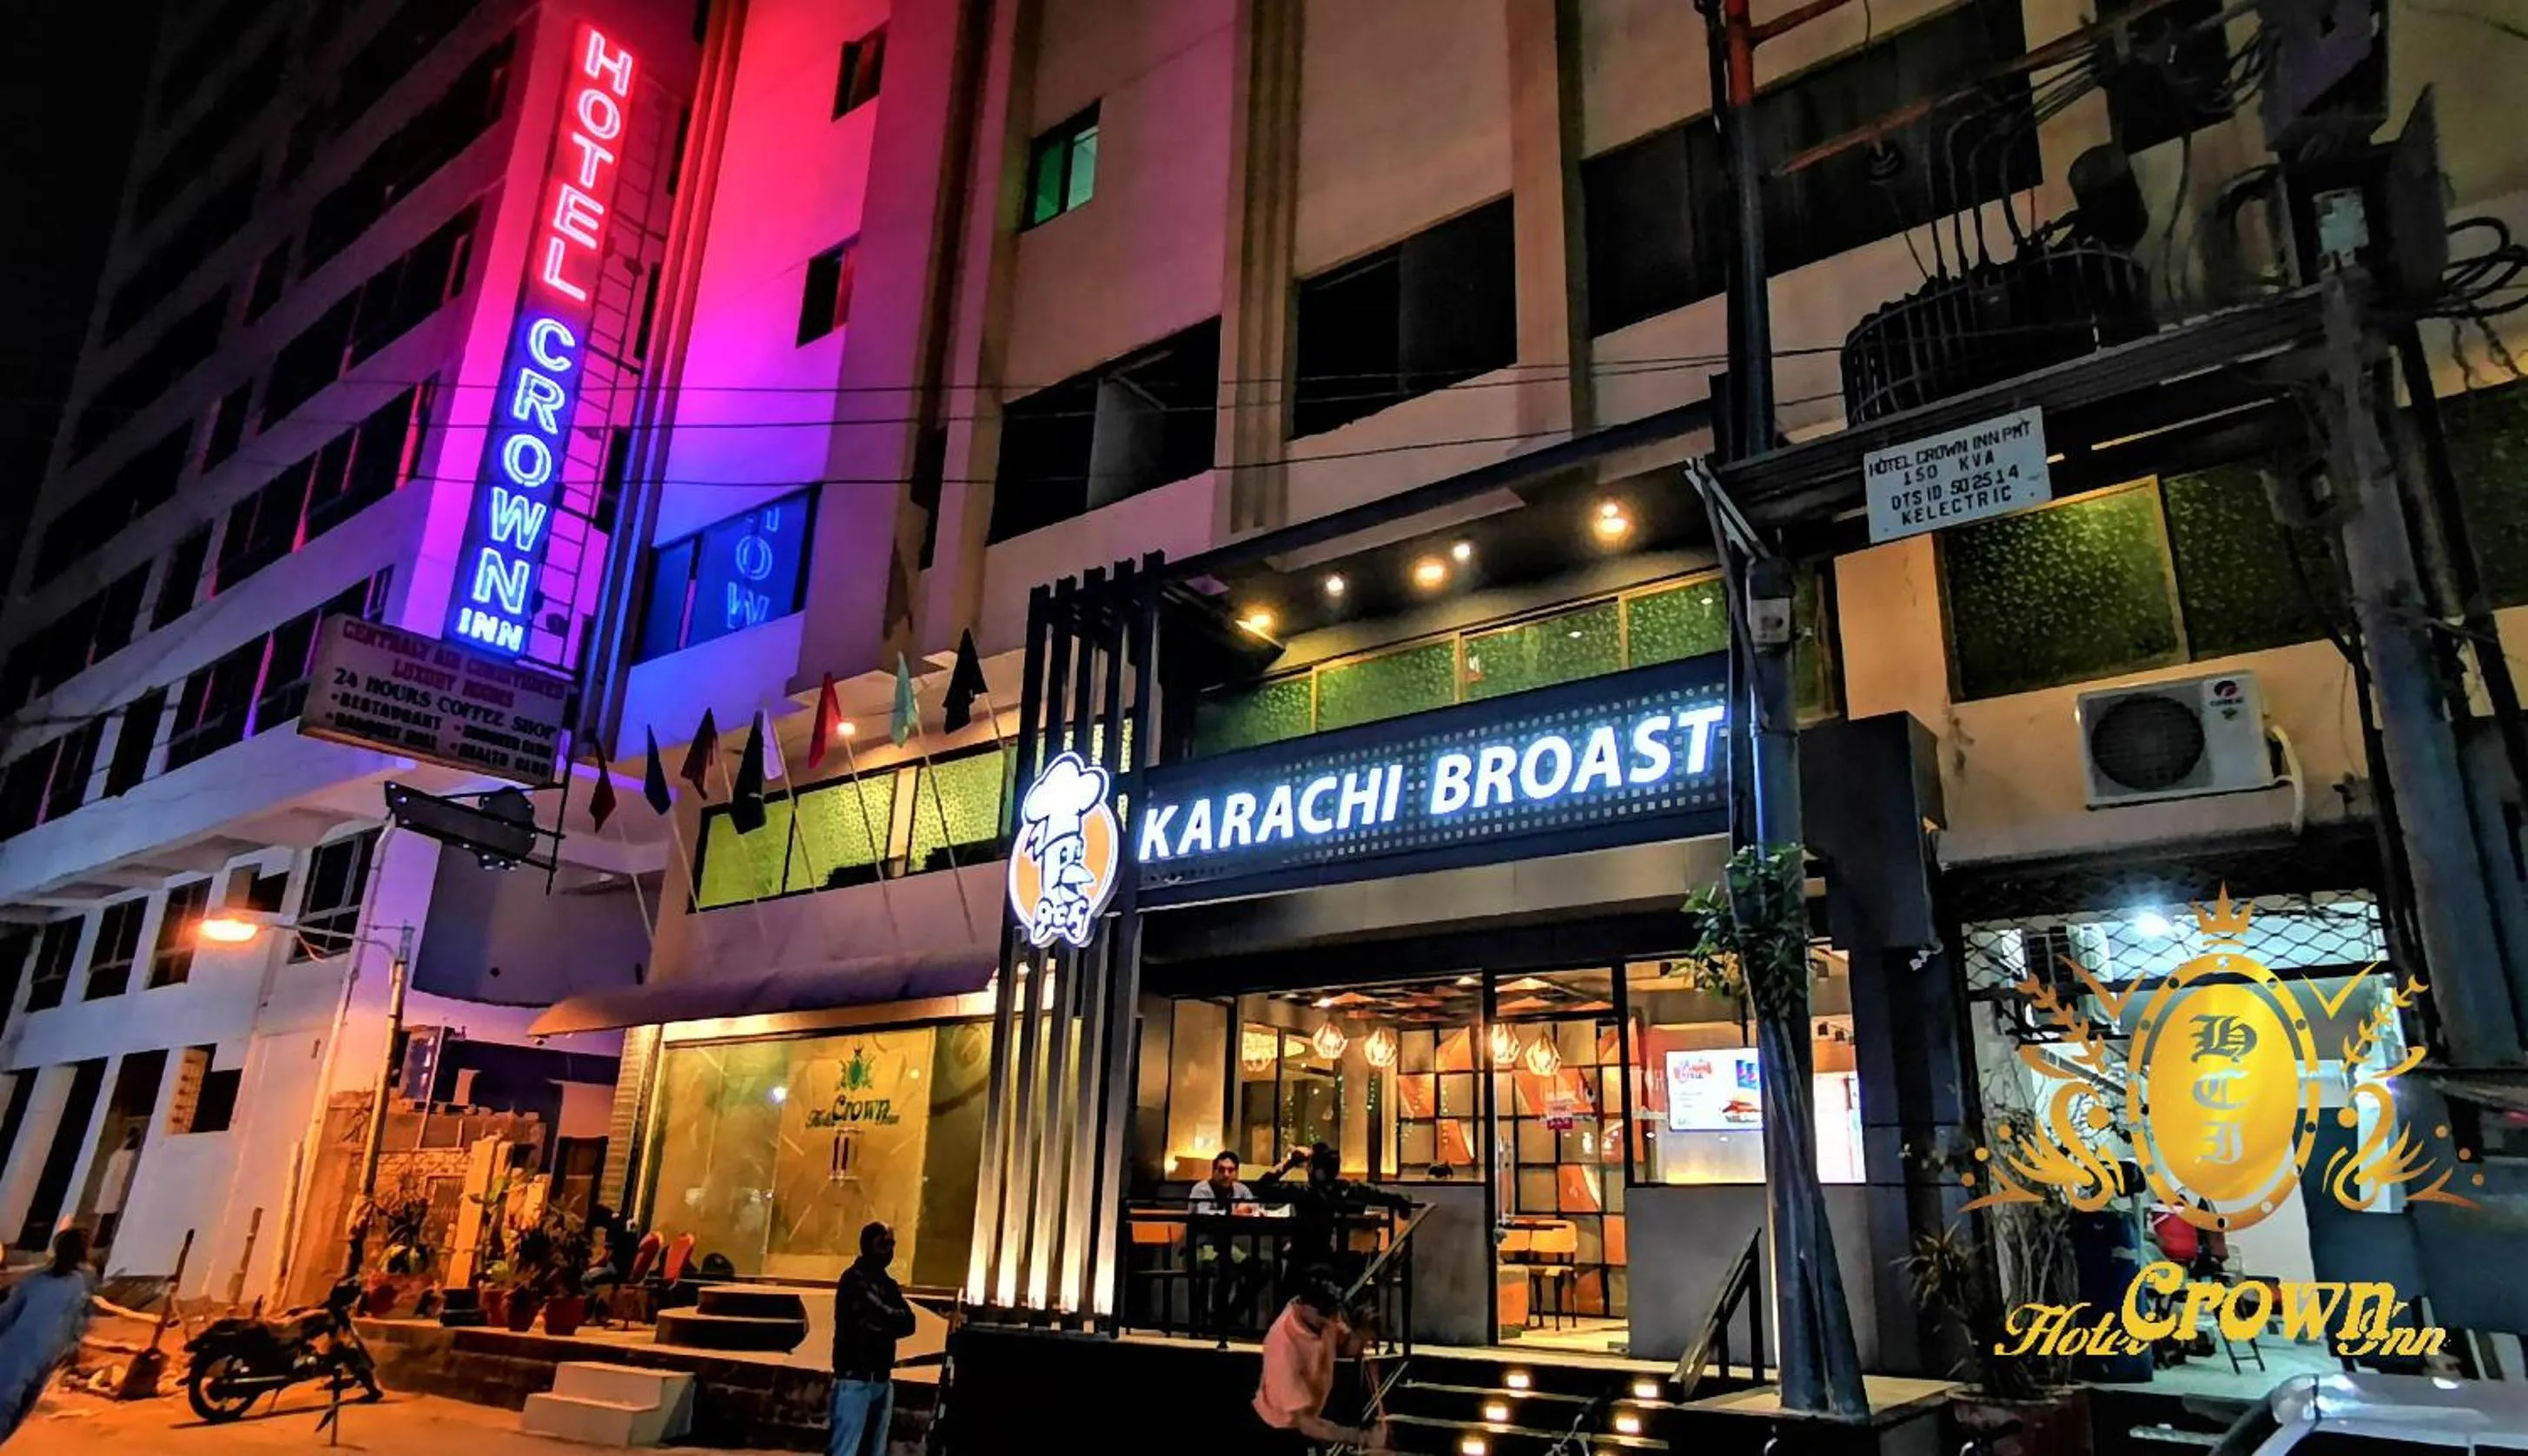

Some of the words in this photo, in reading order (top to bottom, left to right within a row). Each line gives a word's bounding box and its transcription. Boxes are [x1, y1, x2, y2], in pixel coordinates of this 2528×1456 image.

[542, 29, 633, 302] HOTEL
[472, 318, 575, 615] CROWN
[1870, 455, 1912, 477] HOTEL
[1916, 440, 1968, 465] CROWN
[1973, 431, 1999, 451] INN
[2001, 420, 2031, 442] PMT
[1959, 450, 1995, 471] KVA
[1891, 491, 1922, 511] DTS
[1927, 484, 1942, 502] ID
[1950, 464, 2020, 495] 502514
[1902, 485, 2012, 526] KELECTRIC
[457, 607, 524, 652] INN
[366, 676, 432, 708] HOURS
[1137, 764, 1402, 861] KARACHI
[1429, 705, 1727, 815] BROAST
[832, 1094, 890, 1122] Crown
